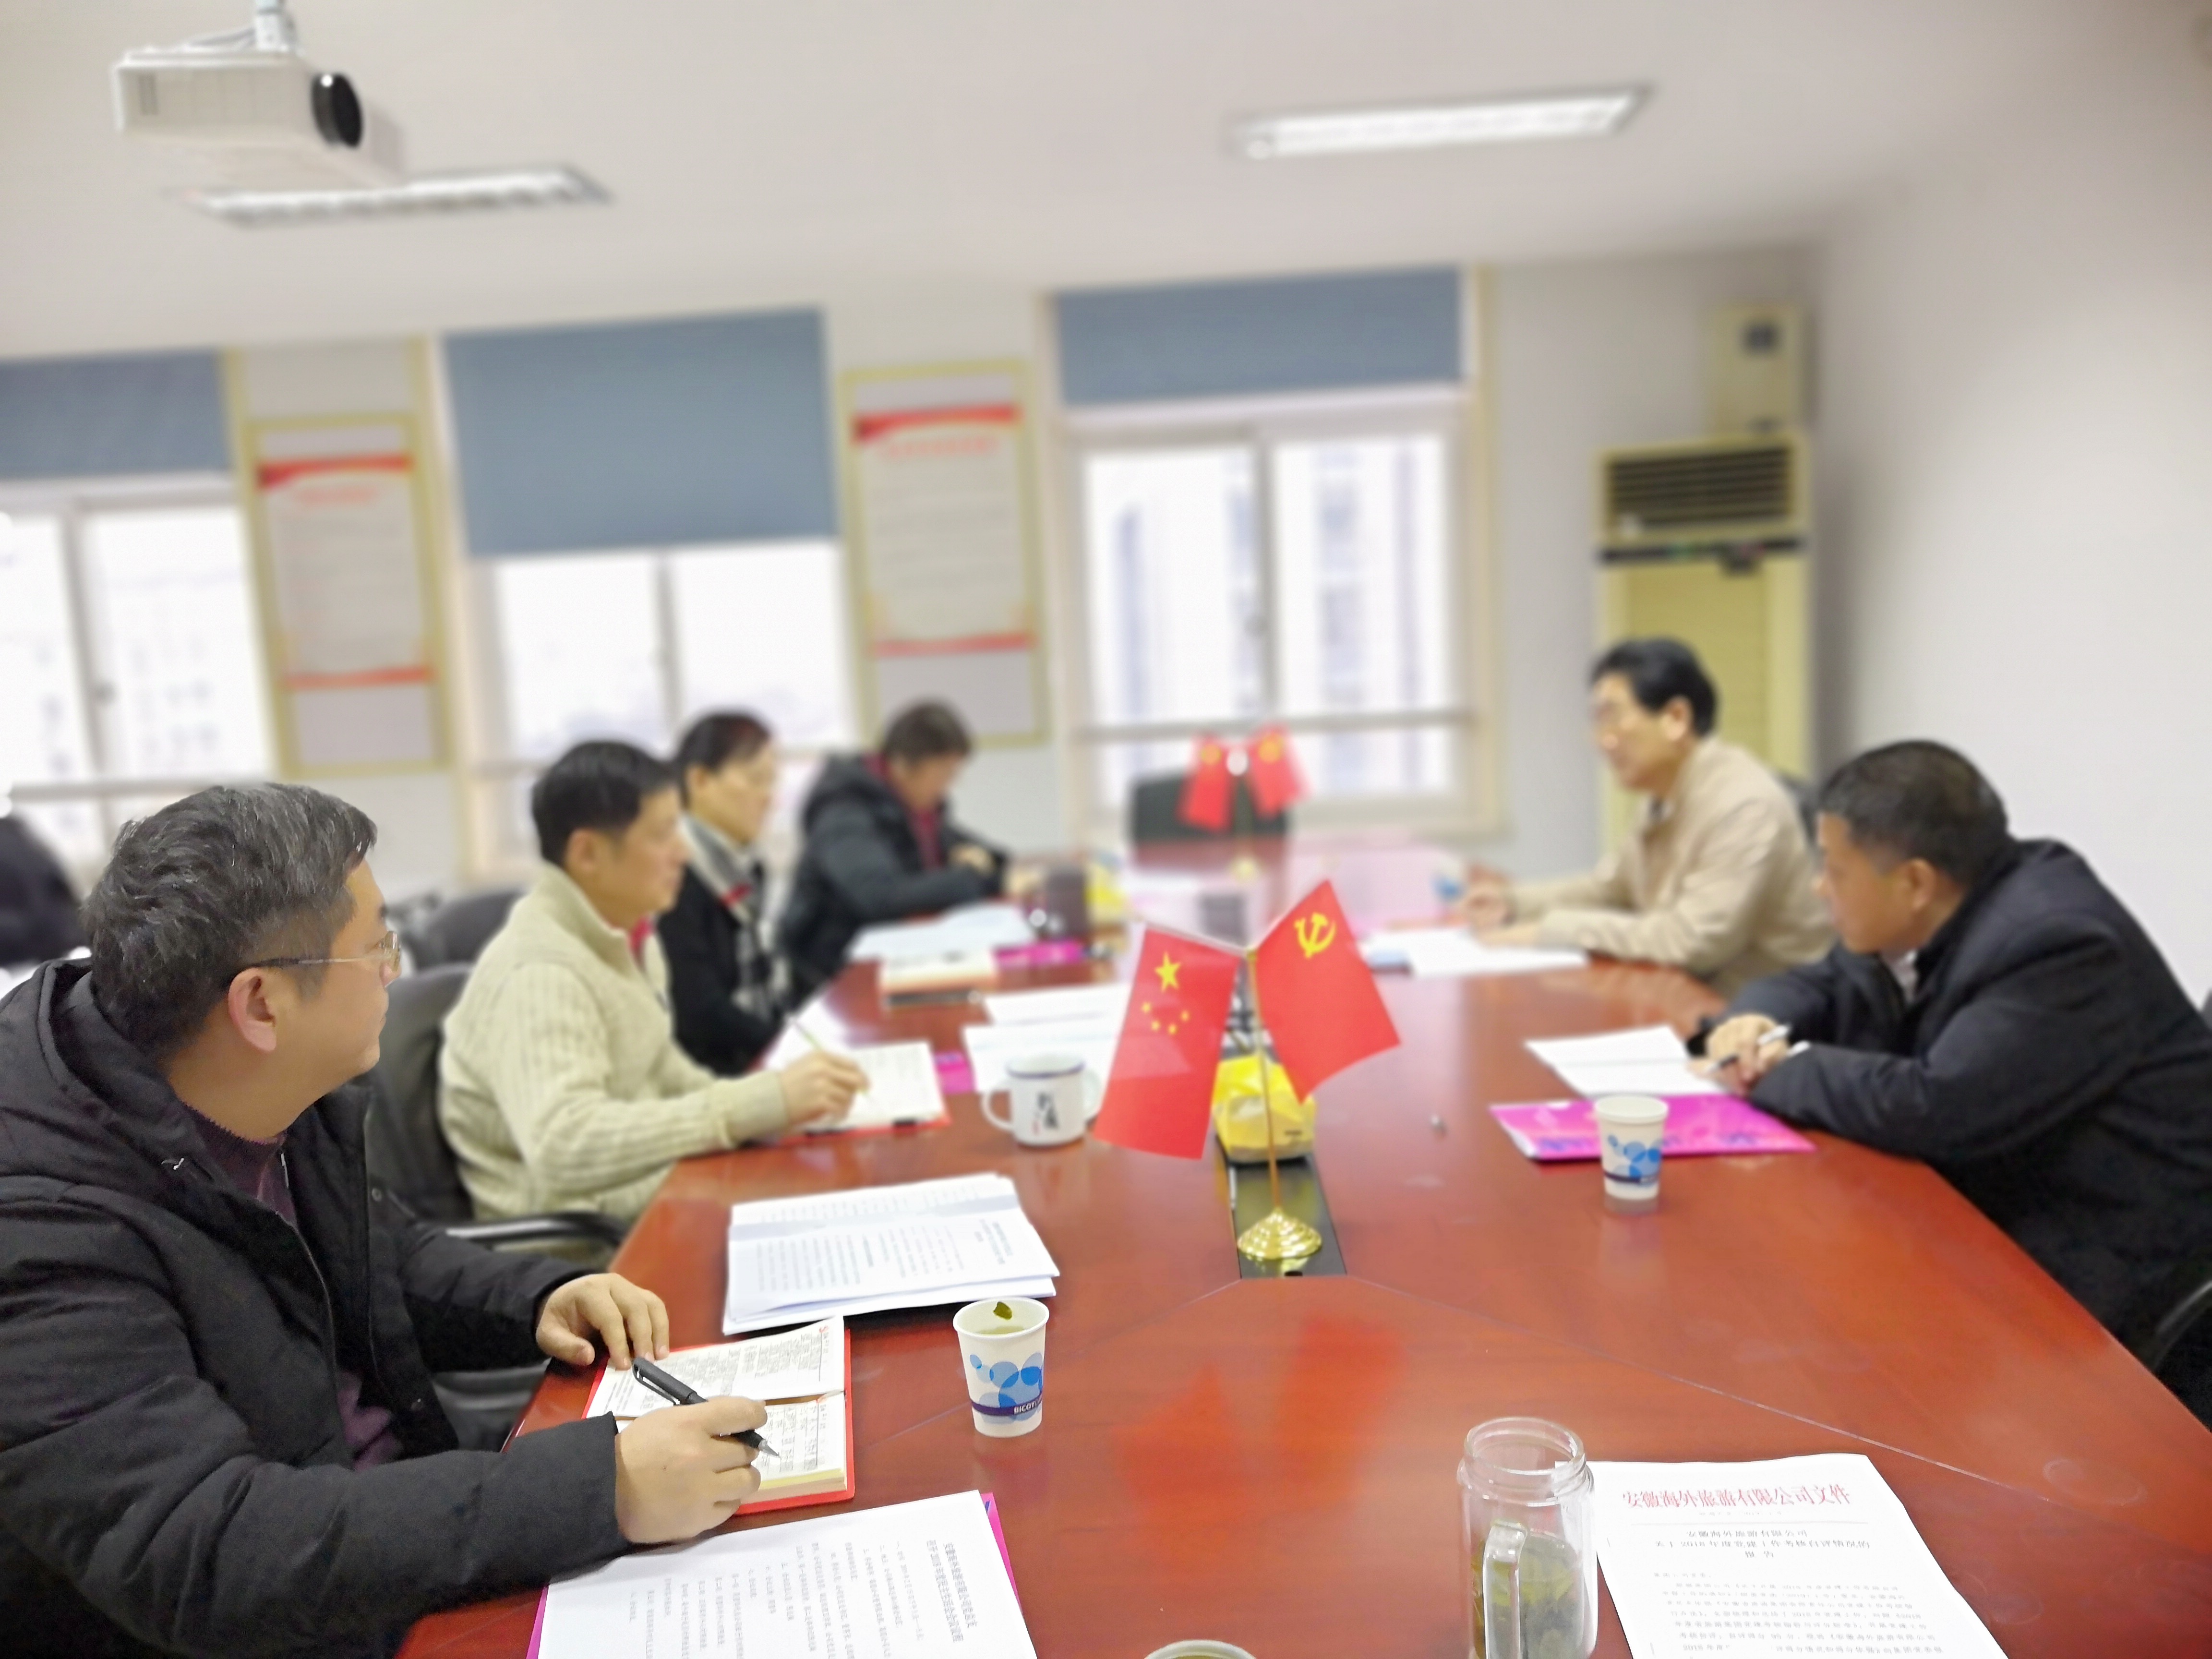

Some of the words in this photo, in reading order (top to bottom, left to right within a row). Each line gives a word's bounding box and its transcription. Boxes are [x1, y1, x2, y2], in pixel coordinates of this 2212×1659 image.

[1623, 1484, 1850, 1508] 安徽海外旅游有限公司文件
